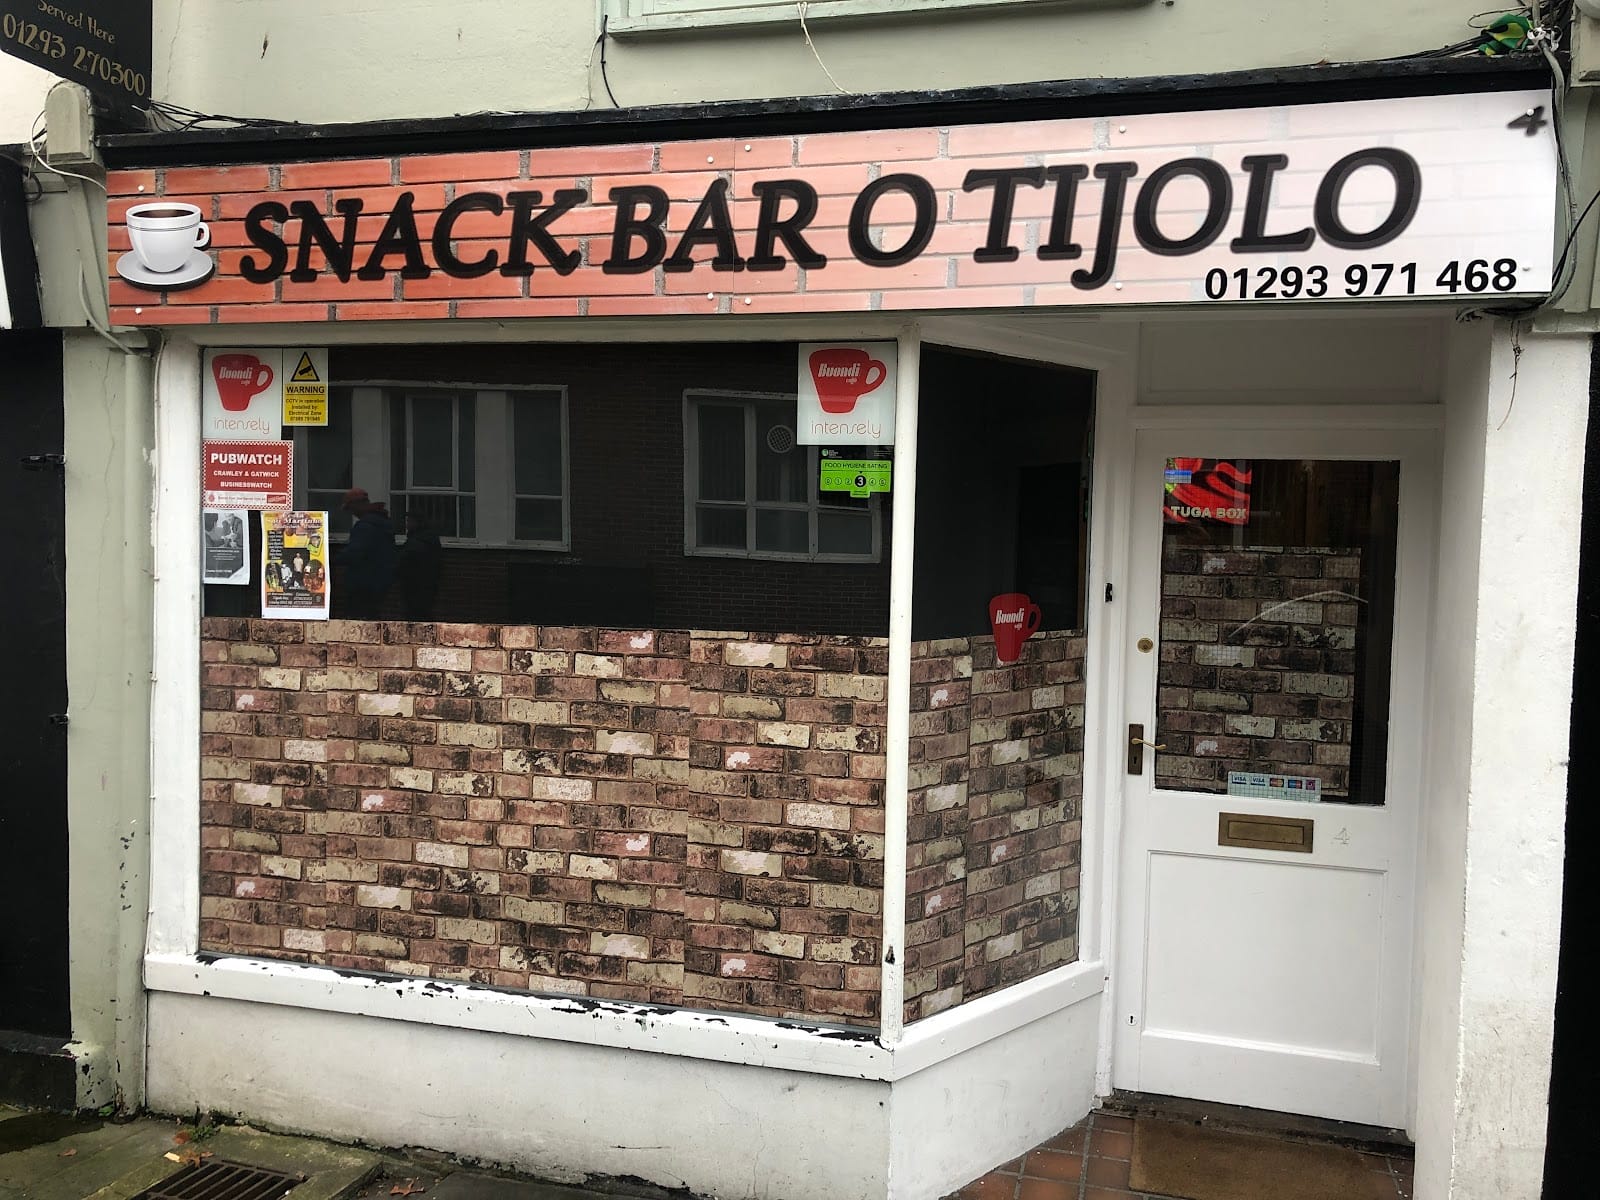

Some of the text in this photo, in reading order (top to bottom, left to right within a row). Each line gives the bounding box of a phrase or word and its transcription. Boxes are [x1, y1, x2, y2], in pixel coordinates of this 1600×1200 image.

[37, 0, 116, 44] Served Here
[3, 13, 146, 96] 01293 270300
[1507, 105, 1548, 137] 4
[239, 146, 1423, 291] SNACK BAR O TIJOLO
[1205, 258, 1518, 299] 01293 971 468
[219, 366, 253, 380] Buondi
[818, 363, 861, 378] Buondi
[286, 386, 325, 394] WARNING
[214, 416, 270, 434] intensely
[811, 420, 882, 438] intensely
[210, 452, 283, 465] PUBWATCH
[220, 481, 273, 489] BUSINESSWATCH
[1170, 506, 1247, 519] TUGA BOX
[995, 607, 1025, 625] Buondi
